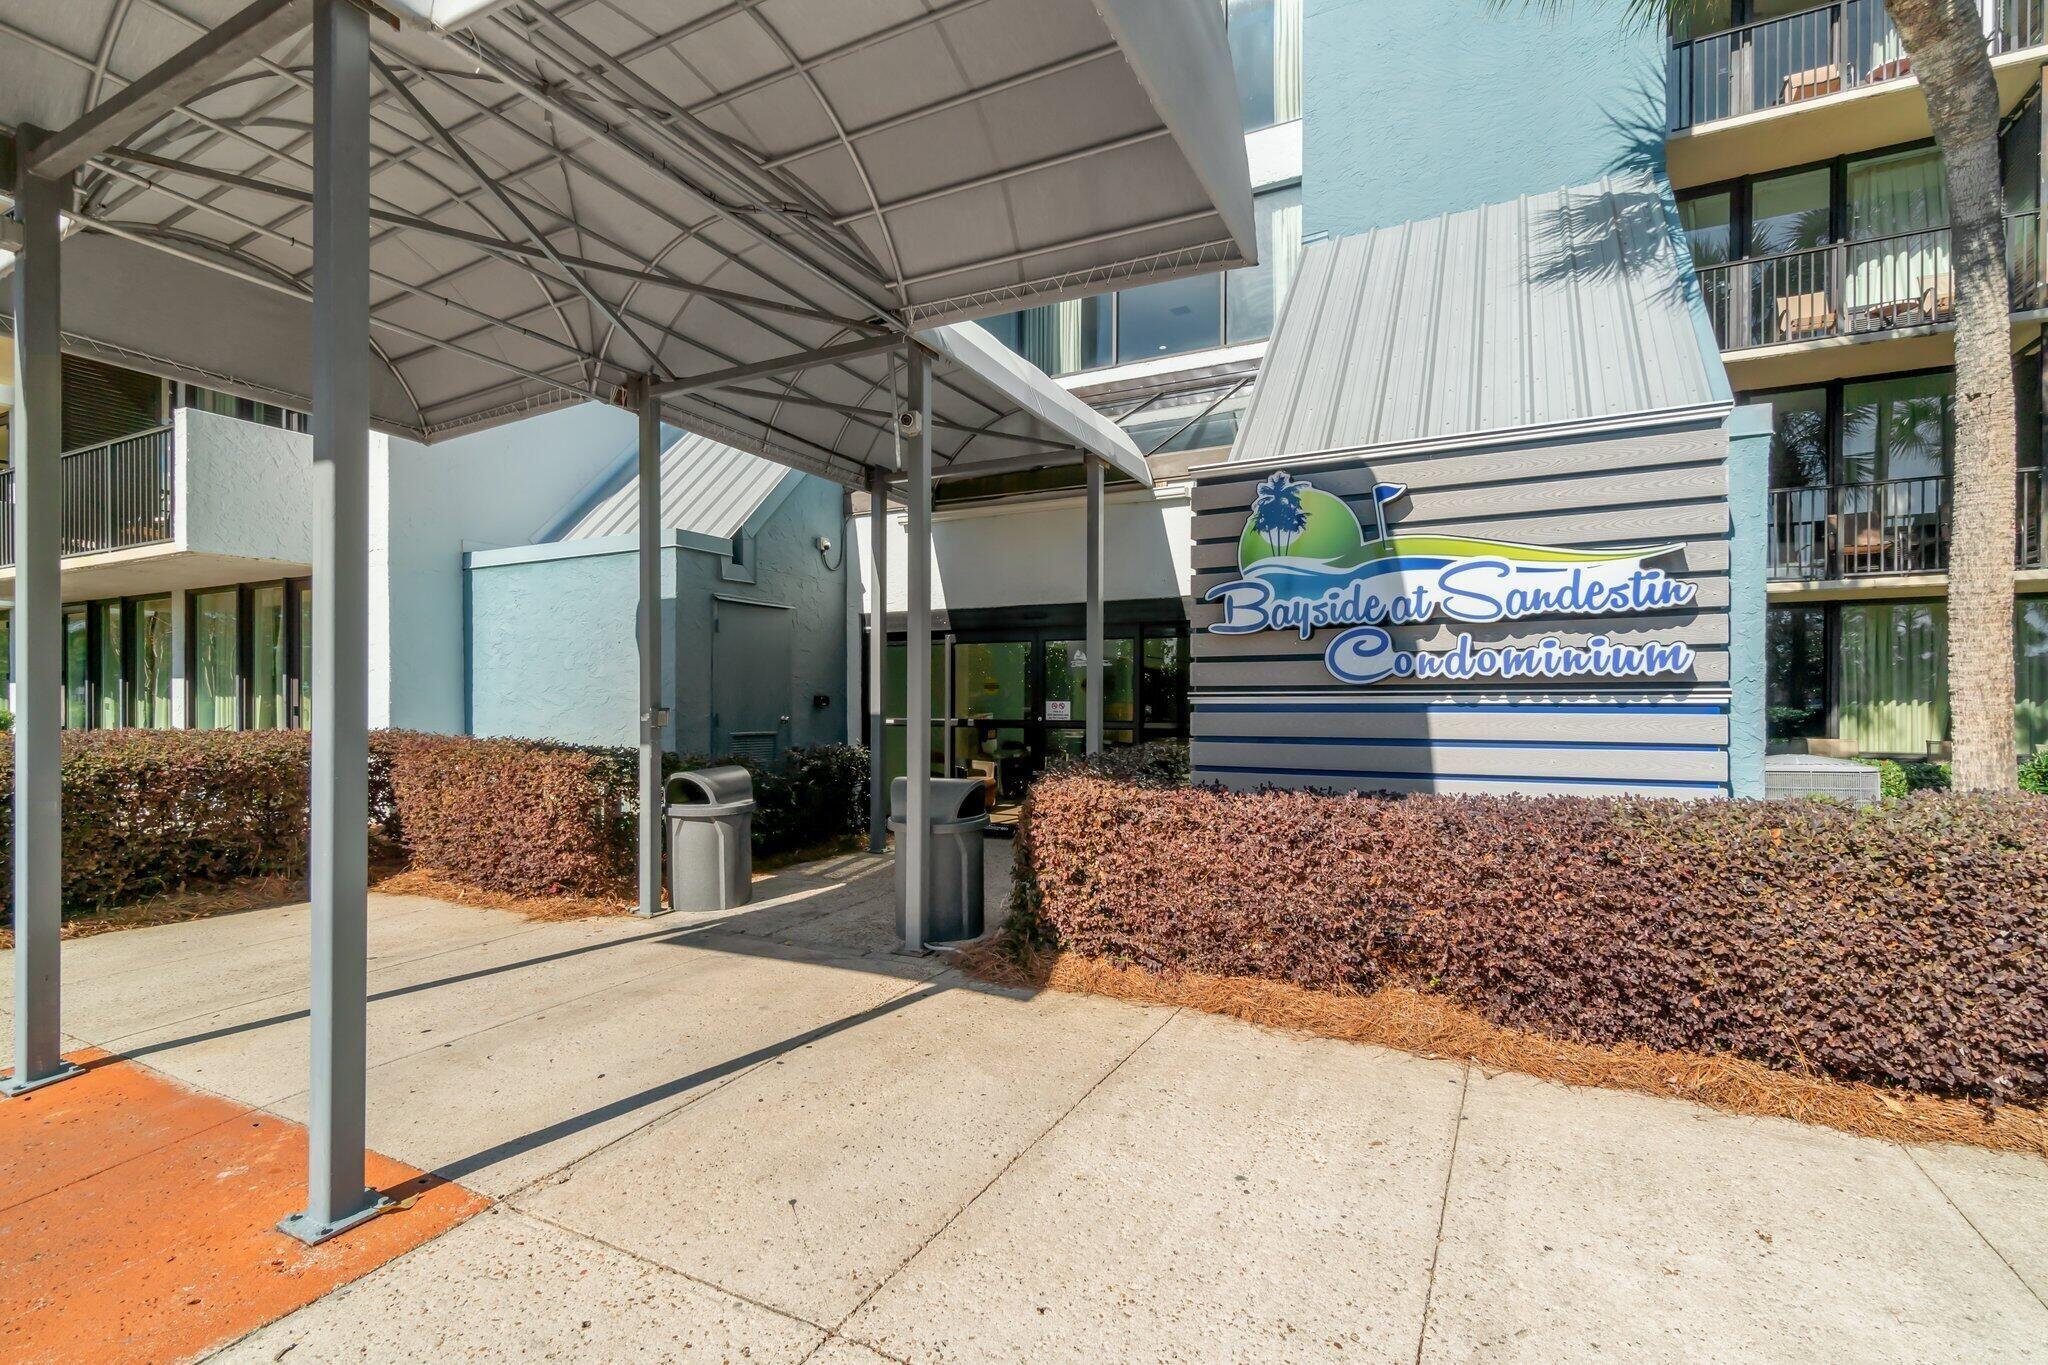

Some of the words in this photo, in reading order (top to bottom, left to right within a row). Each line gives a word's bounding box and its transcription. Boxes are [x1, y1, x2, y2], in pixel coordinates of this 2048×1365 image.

[1207, 582, 1387, 639] Bayside
[1391, 586, 1431, 620] at
[1438, 561, 1692, 619] Sandestin
[1327, 629, 1690, 681] Condominium
